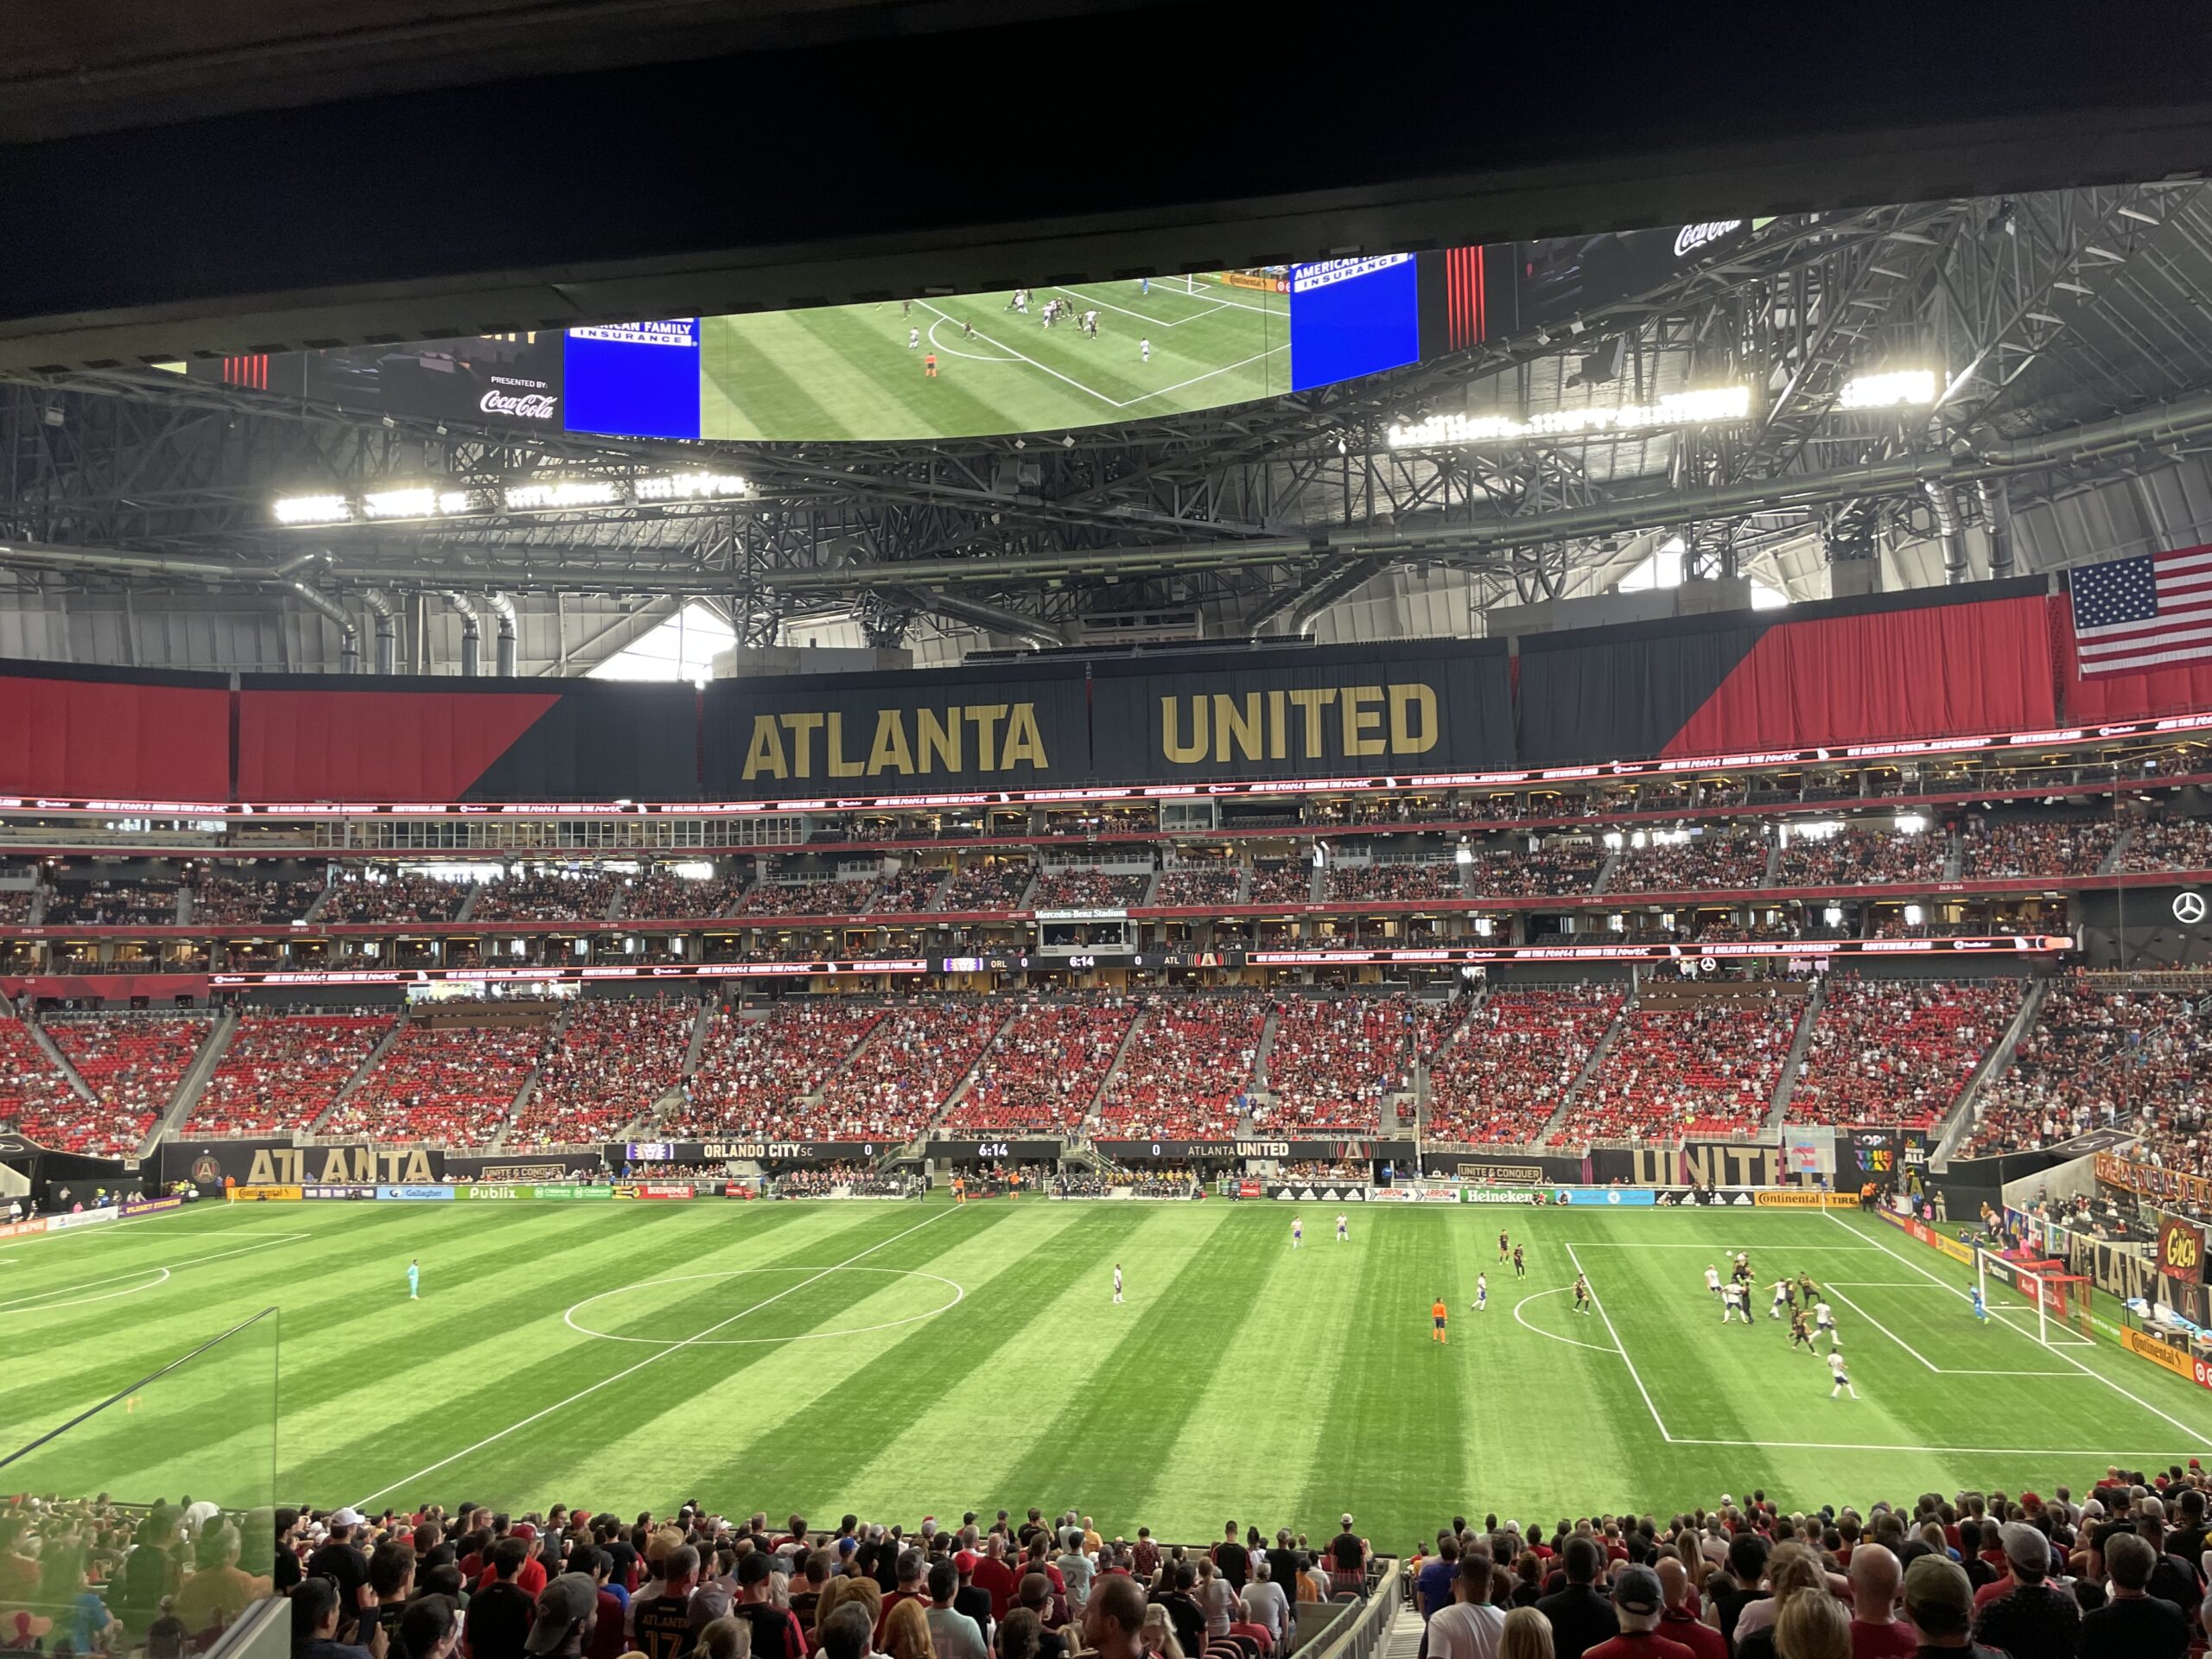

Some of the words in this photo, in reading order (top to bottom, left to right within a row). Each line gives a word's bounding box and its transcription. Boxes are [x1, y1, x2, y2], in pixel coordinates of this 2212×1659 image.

[1294, 256, 1359, 280] AMERICAN
[1304, 256, 1399, 288] INSURANCE
[645, 321, 691, 334] FAMILY
[580, 329, 683, 344] INSURANCE
[492, 376, 535, 388] PRESENTED
[741, 702, 1050, 779] ATLANTA
[1160, 683, 1439, 764] UNITED
[1035, 910, 1092, 919] Mercedes-Benz
[1093, 909, 1127, 918] Stadium
[990, 960, 1007, 969] ORL
[1020, 957, 1028, 968] 0
[1069, 956, 1094, 967] 6:14
[1135, 956, 1141, 965] 0
[1164, 957, 1180, 965] ATL
[703, 1143, 765, 1158] ORLANDO
[768, 1143, 801, 1157] CITY
[801, 1147, 813, 1157] SC
[864, 1145, 873, 1156] 0
[978, 1143, 1008, 1156] 6:14
[1152, 1144, 1160, 1156] 0
[1188, 1145, 1236, 1156] ATLANTA
[1236, 1141, 1289, 1157] UNITED
[1904, 1154, 1924, 1163] ALL
[485, 1167, 512, 1179] UNITE
[1460, 1166, 1487, 1177] UNITE
[1488, 1167, 1496, 1178] &
[1497, 1168, 1540, 1179] CONQUER
[406, 1189, 442, 1199] Gallagher
[470, 1187, 517, 1199] Publix
[1467, 1190, 1533, 1203] Heineken
[1758, 1193, 1820, 1204] Continental
[2131, 1332, 2175, 1365] Continental
[642, 1614, 688, 1629] ATLANTA
